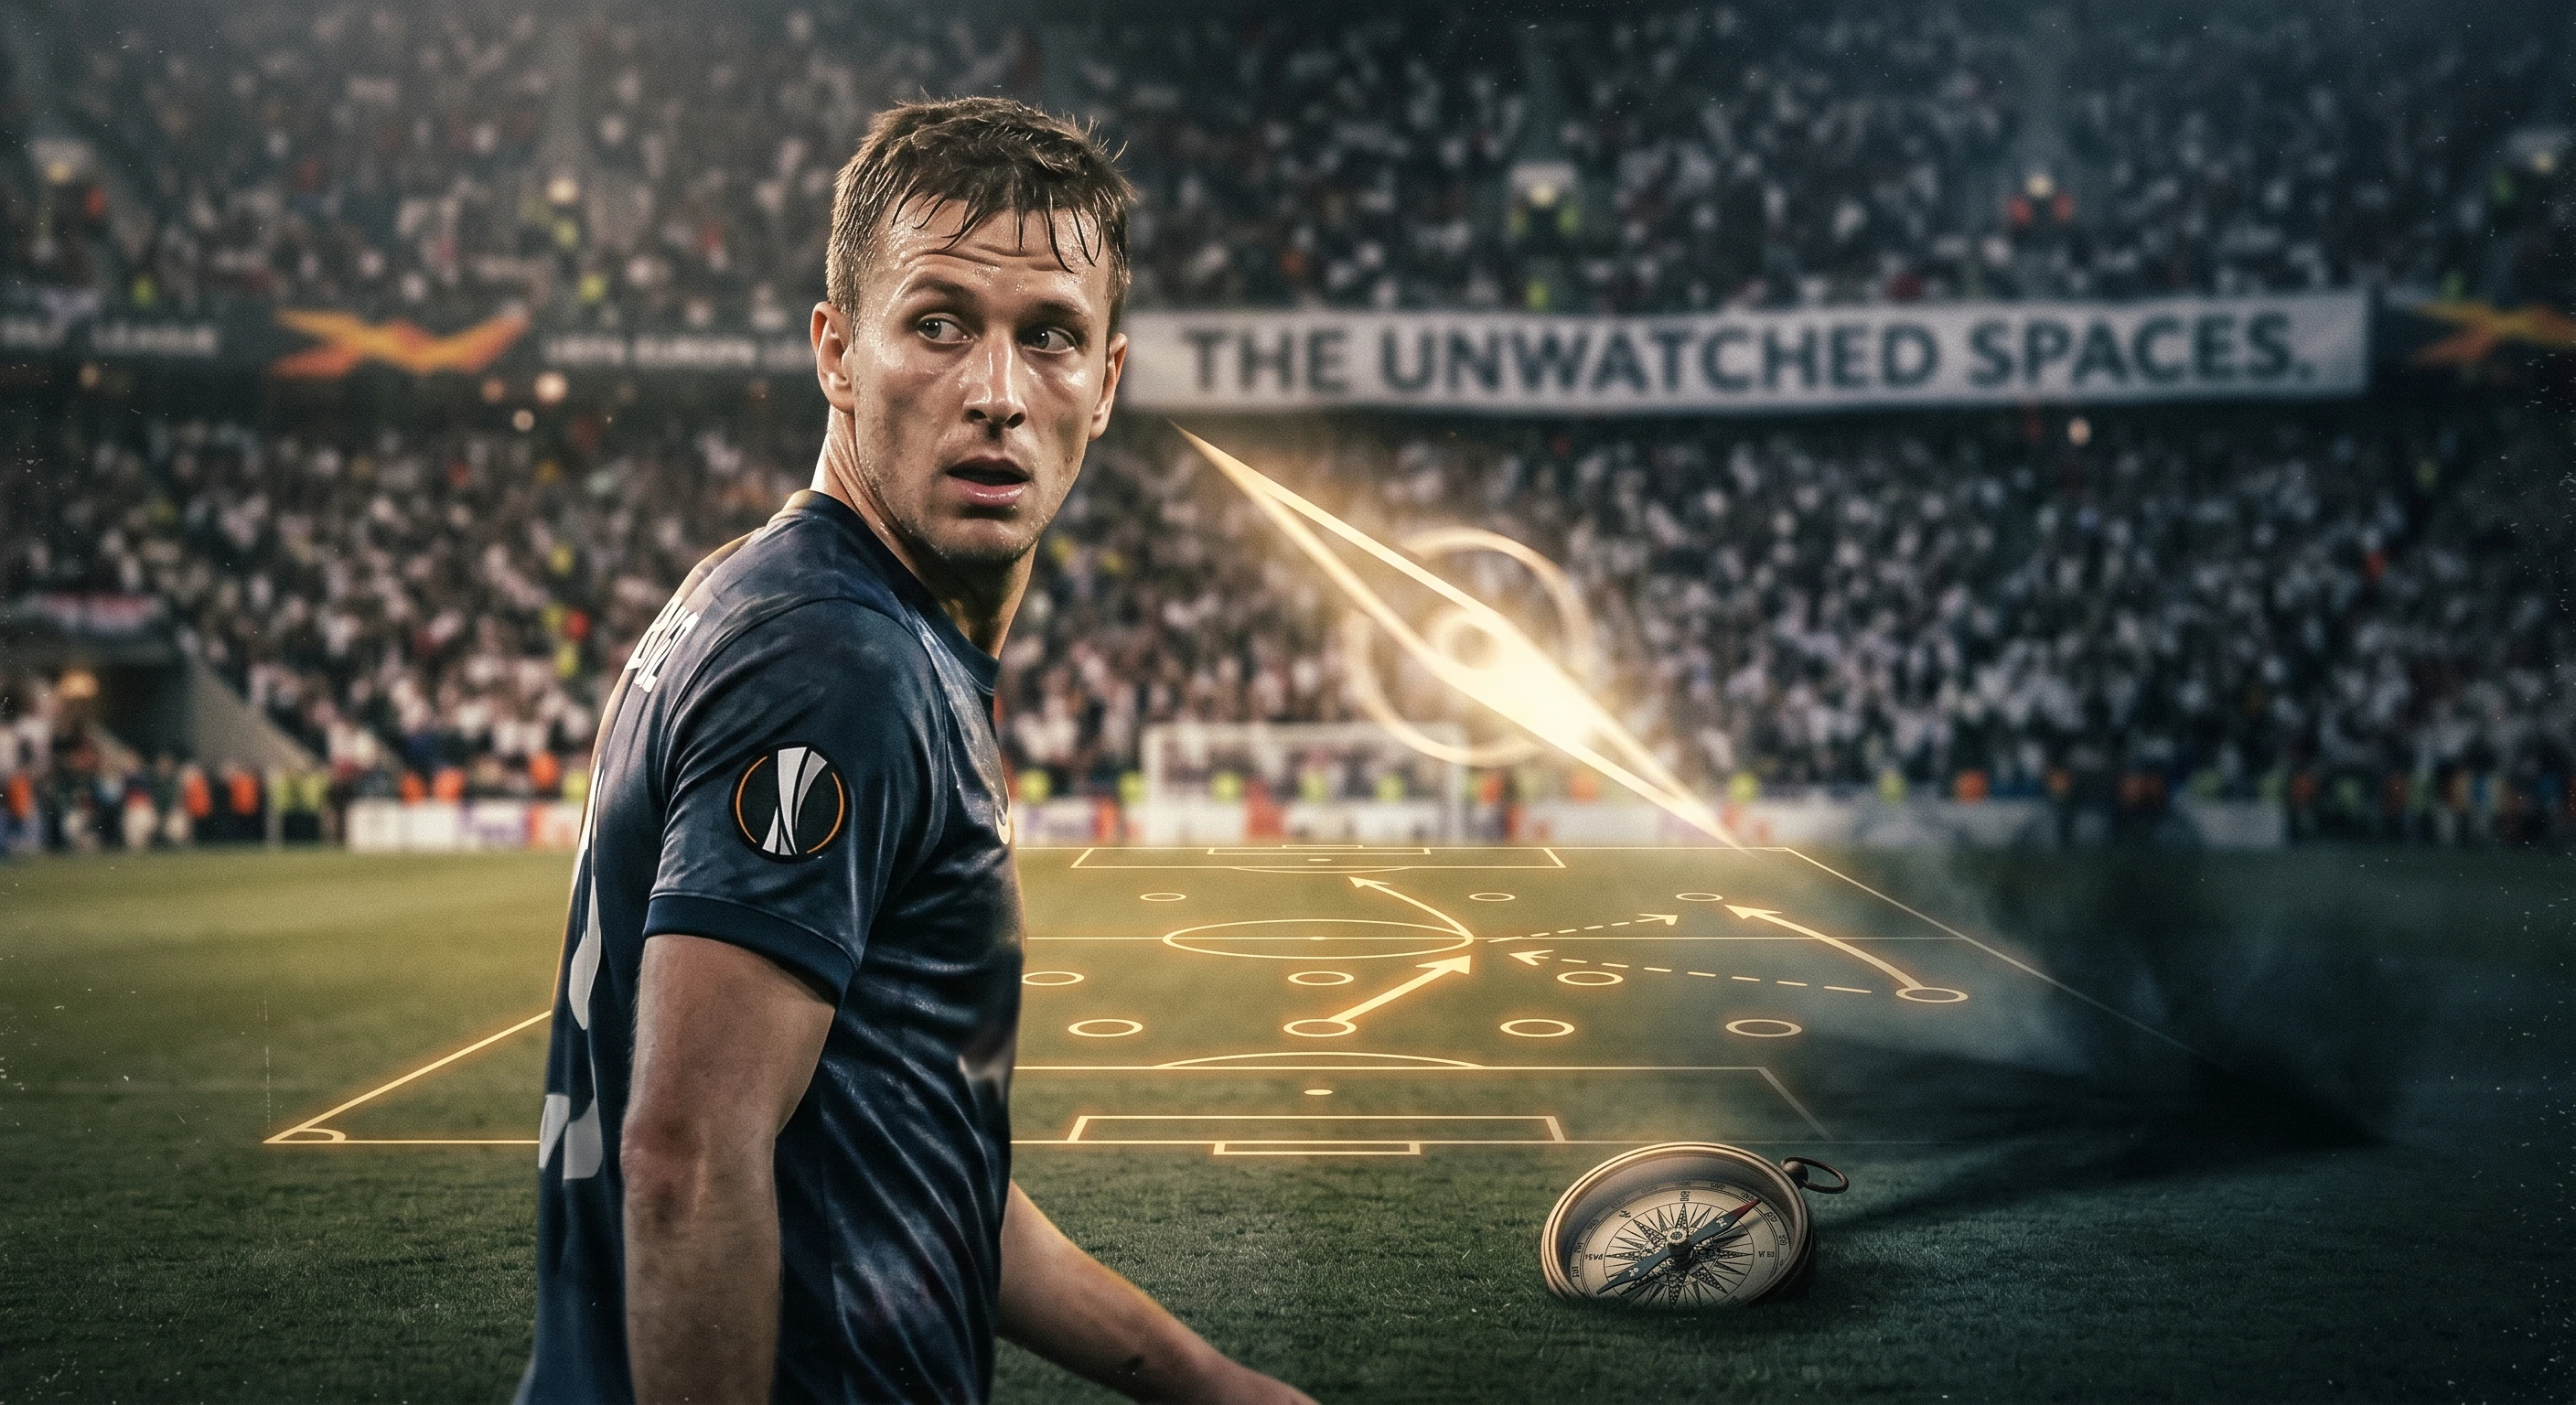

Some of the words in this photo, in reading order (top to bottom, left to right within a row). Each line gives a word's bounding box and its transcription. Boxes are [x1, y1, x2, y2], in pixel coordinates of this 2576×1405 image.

[1182, 327, 1354, 391] THE
[1378, 323, 1941, 391] UNWATCHED
[1969, 313, 2314, 386] SPACES.
